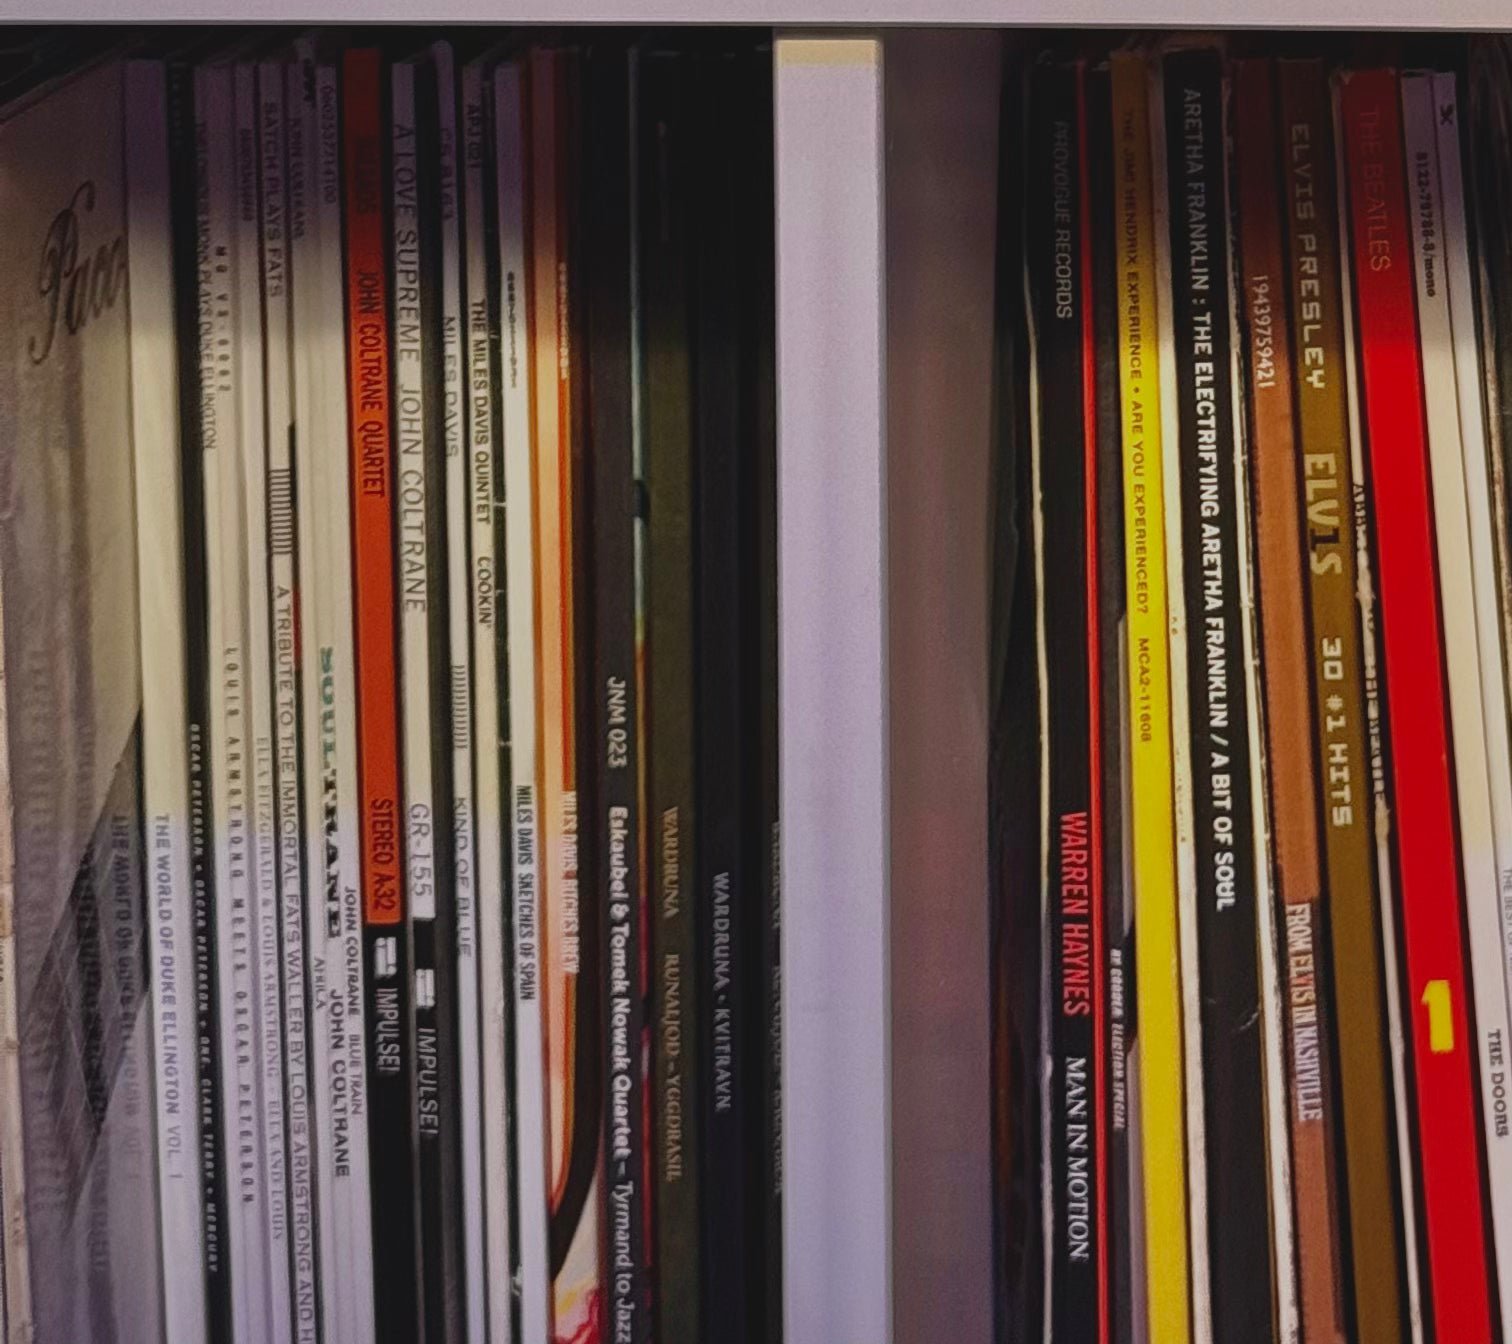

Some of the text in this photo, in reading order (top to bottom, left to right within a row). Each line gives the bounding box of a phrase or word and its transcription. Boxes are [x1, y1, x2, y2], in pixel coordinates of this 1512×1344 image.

[260, 102, 283, 298] SATCH PLAYS FATS
[1291, 122, 1325, 388] ELVIS PRESLEY
[353, 270, 388, 496] JOHN COLTRANE QUARTET
[392, 122, 426, 612] A LOVE SUPREME JOHN COLTRANE
[469, 298, 484, 332] THE
[471, 338, 486, 390] MILES
[1250, 274, 1274, 388] 19439759421
[472, 396, 487, 444] DAVIS
[474, 450, 490, 524] QUINTET
[1183, 86, 1234, 910] ARETHA FRANKLIN THE ELECTRIFYING ARETHA FRANKLIN A BIT OF SOUL
[318, 646, 342, 938] SOULTRANE
[1318, 636, 1354, 826] 30 #1 HITS
[411, 802, 432, 896] GR-155
[1060, 810, 1089, 1016] WARREN HAYNES
[327, 988, 350, 1176] JOHN COLTRANE
[343, 886, 362, 1114] JOHN COLTRANE BLUE TRAIN
[606, 674, 635, 1344] JNM 023 Eskaubel & Tomek Nowak Quartet Tyrmand to Jazz
[661, 806, 680, 1182] WARDRUNA RUNALJOD YGGDRASIL
[1284, 902, 1324, 1120] FROM ELVIS IN NASHVILLE
[1421, 980, 1454, 1054] 1
[1066, 1056, 1089, 1262] MAN IN MOTION
